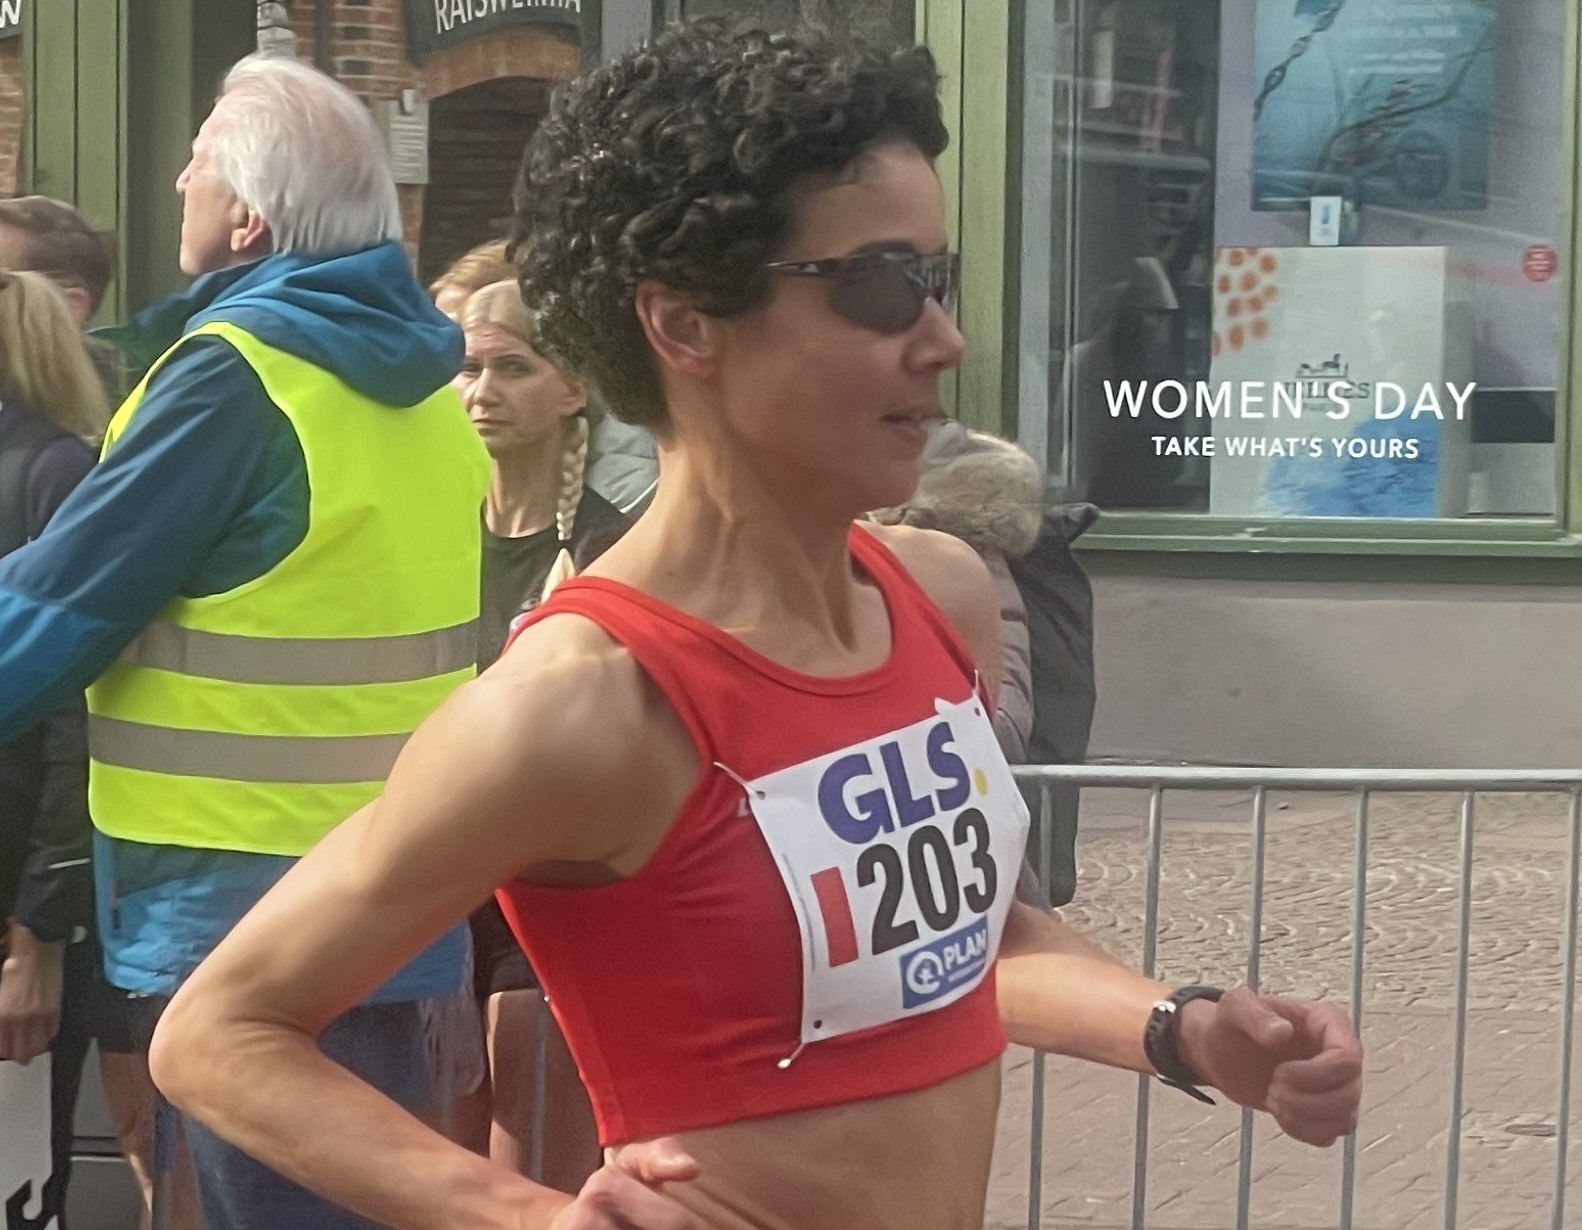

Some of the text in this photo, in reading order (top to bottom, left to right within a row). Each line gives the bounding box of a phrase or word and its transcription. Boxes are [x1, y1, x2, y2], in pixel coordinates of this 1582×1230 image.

[1103, 379, 1476, 420] WOMEN'S DAY
[1152, 436, 1420, 459] TAKE WHAT'S YOURS
[856, 807, 998, 956] 203
[943, 928, 987, 971] PLAN
